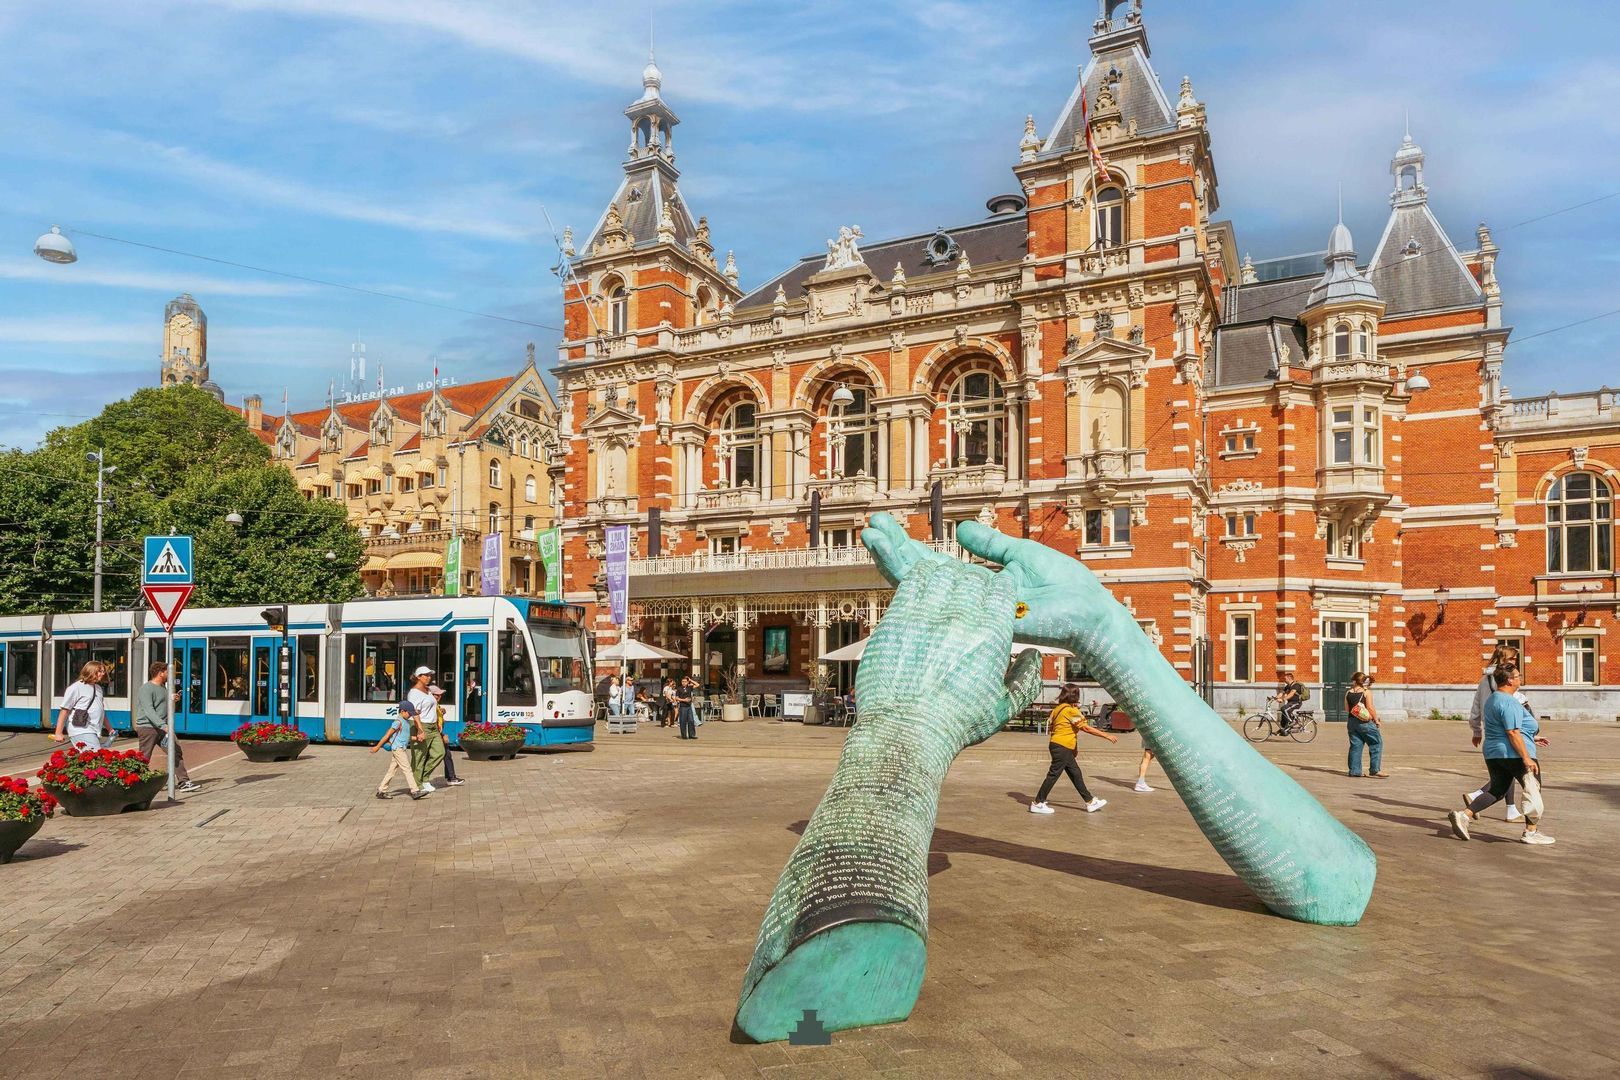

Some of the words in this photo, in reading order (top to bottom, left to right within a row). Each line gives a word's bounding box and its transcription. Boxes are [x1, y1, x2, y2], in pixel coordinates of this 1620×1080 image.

[345, 386, 404, 403] AMERICAN
[822, 883, 849, 892] speak
[874, 884, 893, 893] mind
[802, 903, 812, 912] on
[826, 892, 847, 901] your
[850, 890, 887, 899] children.
